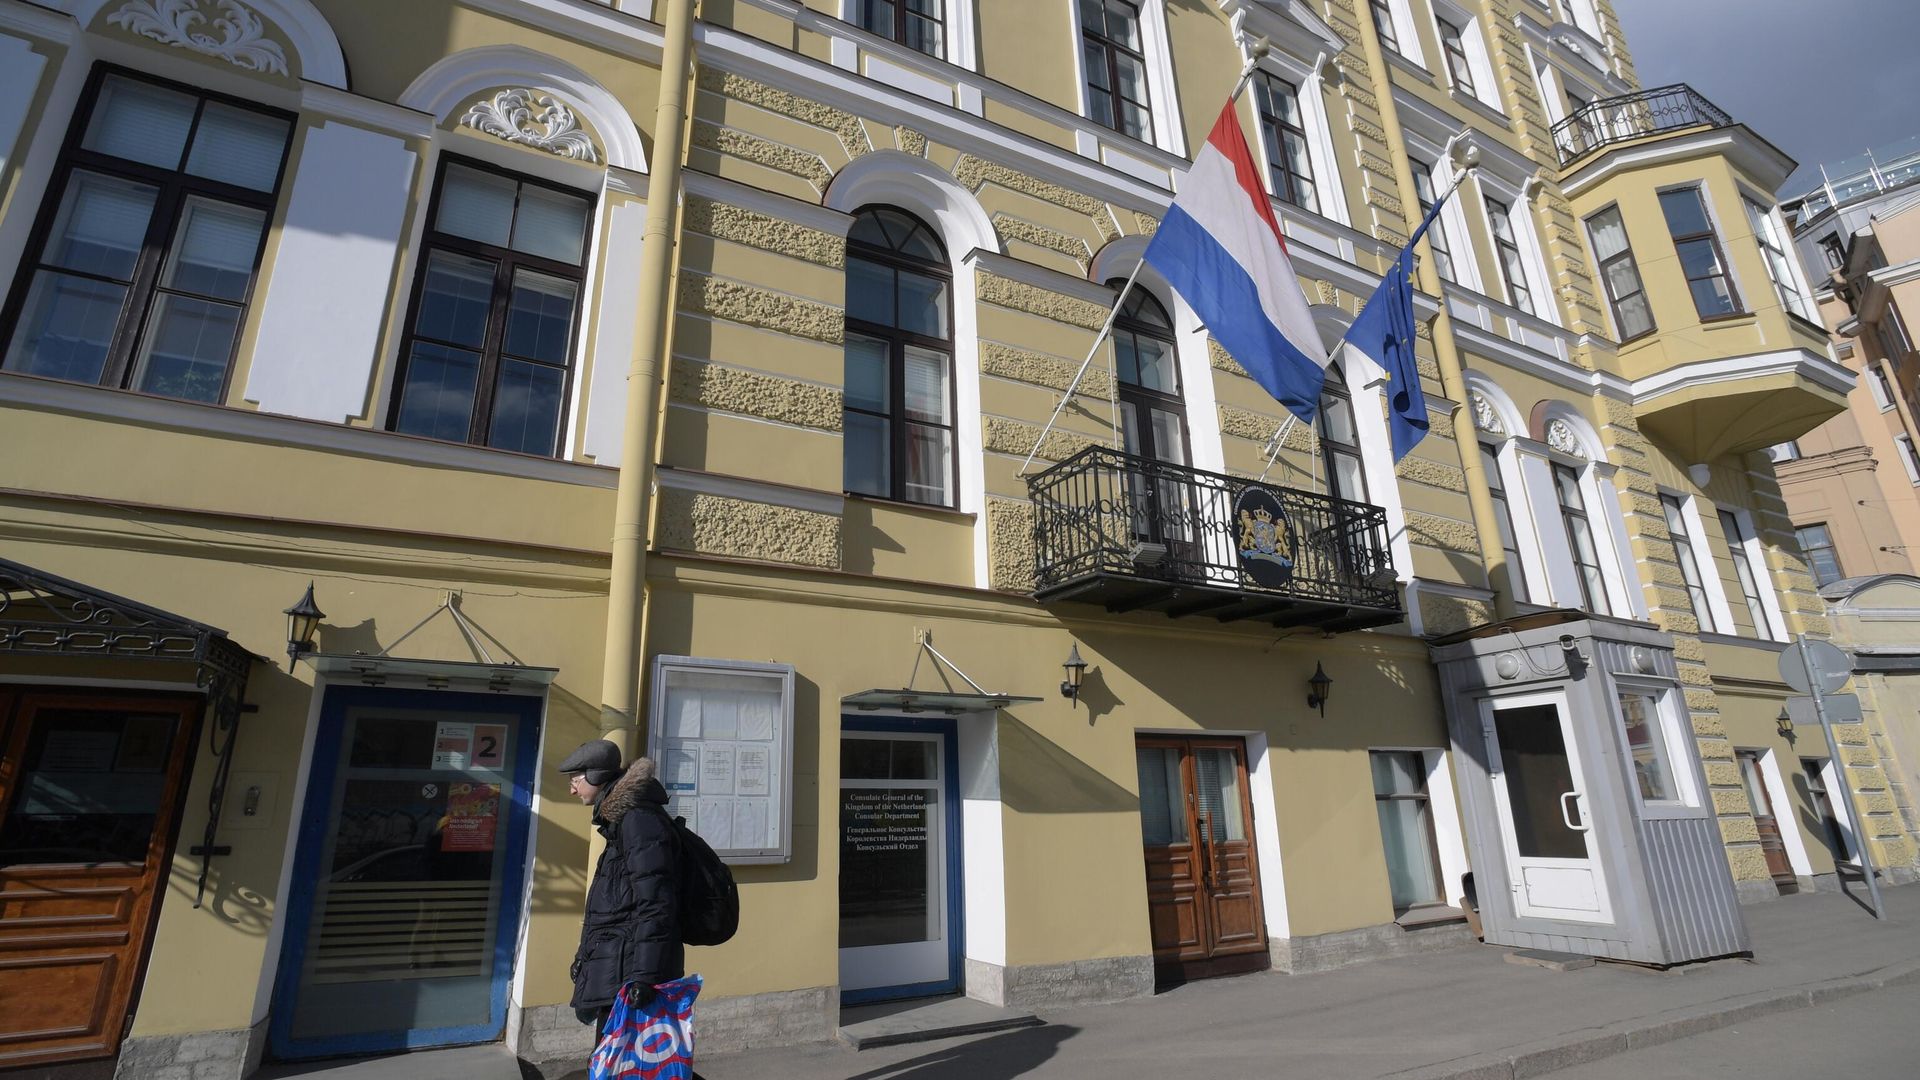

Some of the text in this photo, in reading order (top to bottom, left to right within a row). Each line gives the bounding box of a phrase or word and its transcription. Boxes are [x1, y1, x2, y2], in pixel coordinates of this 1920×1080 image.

[479, 736, 497, 757] 2
[845, 803, 874, 811] Kingdom
[884, 813, 920, 821] Department
[856, 844, 898, 852] Консульский
